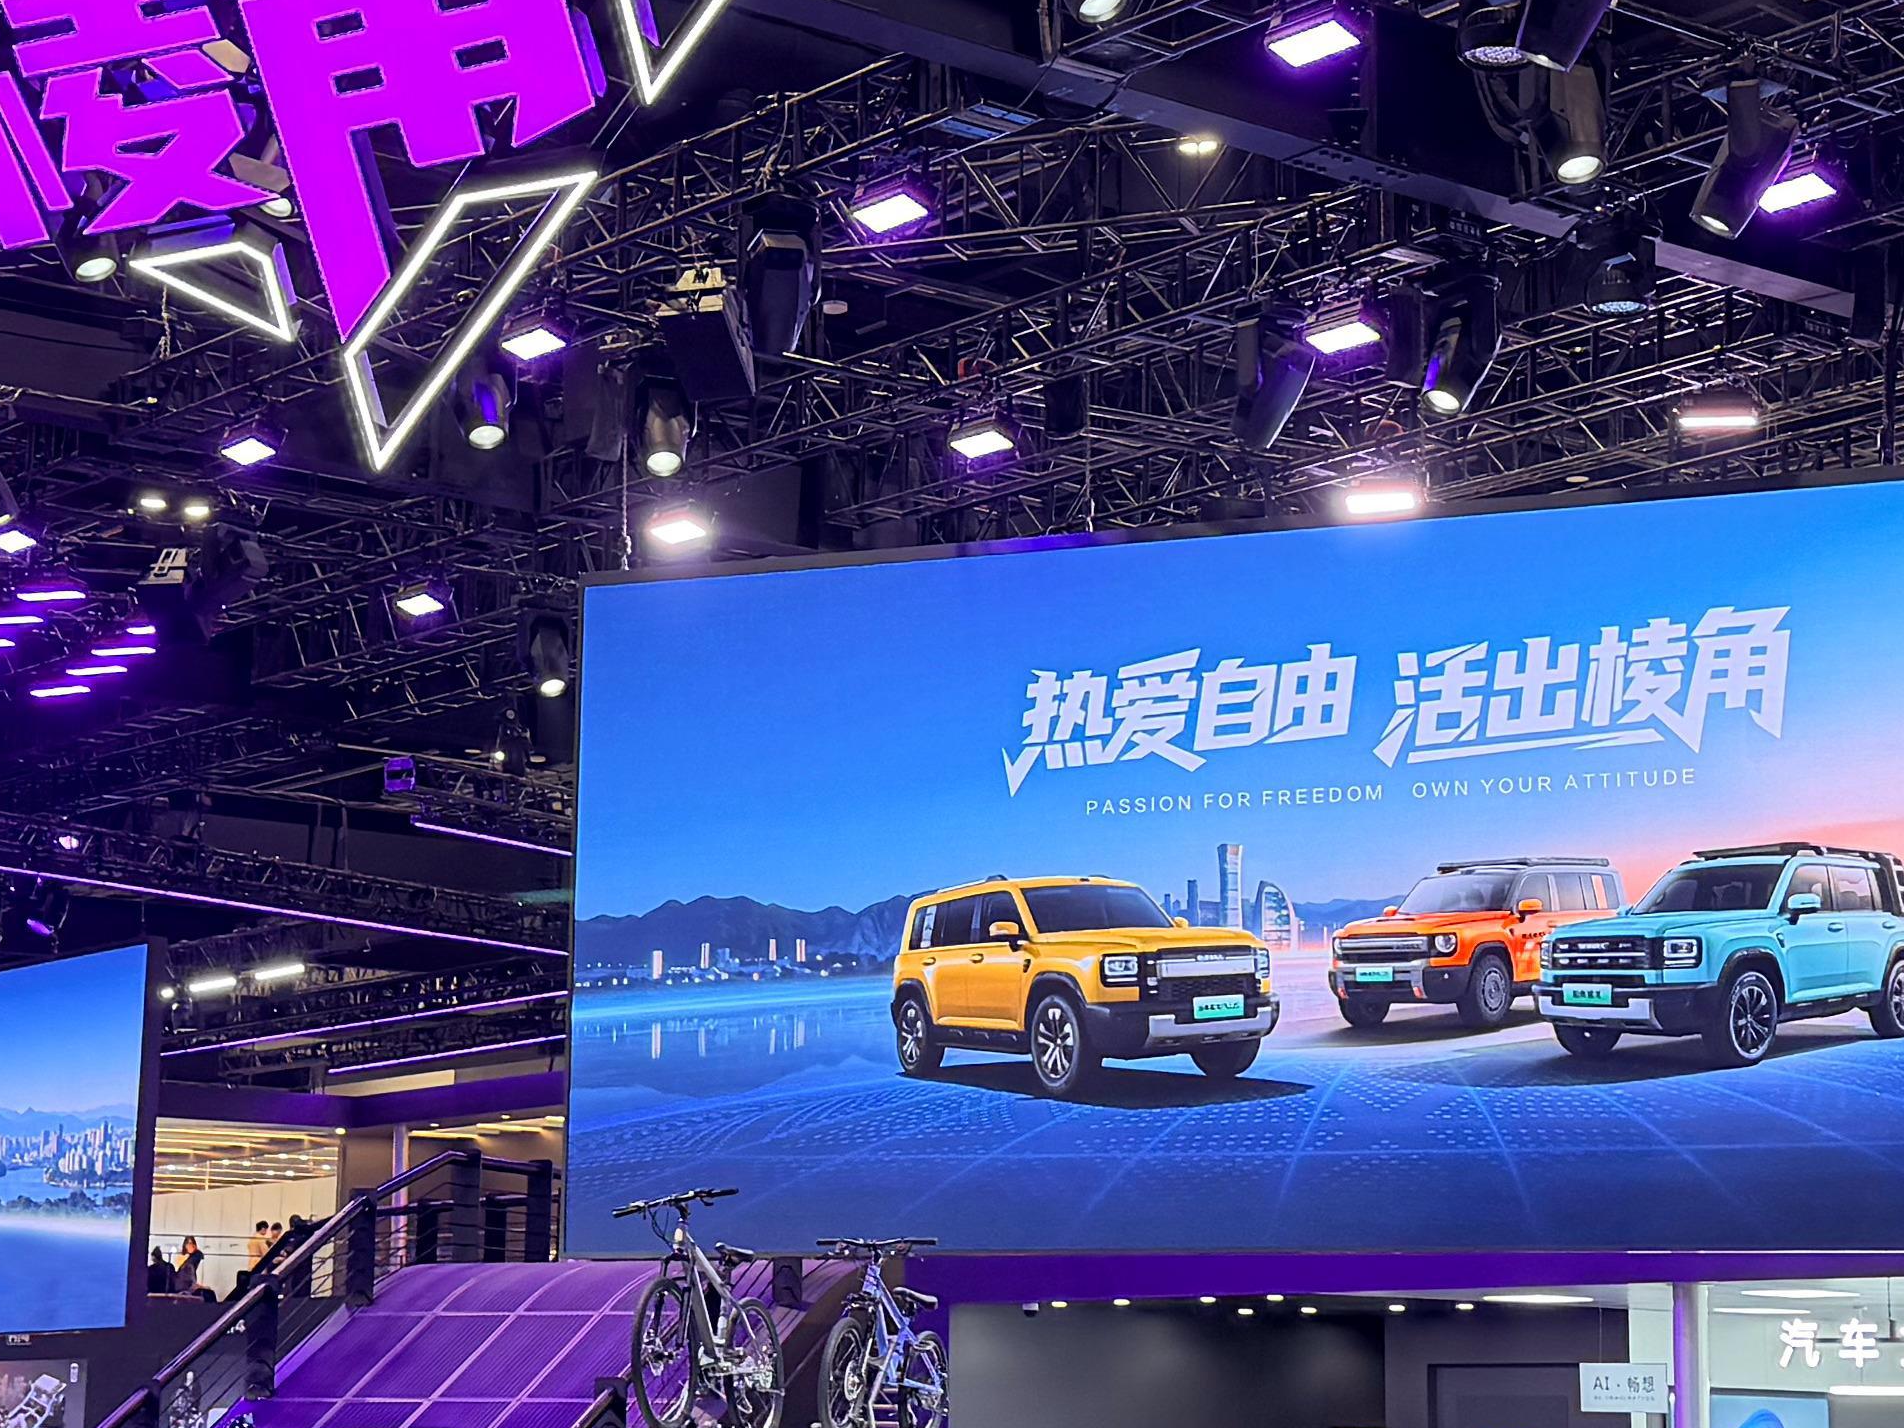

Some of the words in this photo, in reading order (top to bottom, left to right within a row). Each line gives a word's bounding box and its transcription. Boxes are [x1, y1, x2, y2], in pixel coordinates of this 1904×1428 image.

[1001, 642, 1358, 798] 热爱自由
[1373, 605, 1792, 768] 活出棱角
[1085, 794, 1193, 816] PASSION
[1203, 791, 1251, 810] FOR
[1262, 784, 1383, 806] FREEDOM
[1412, 779, 1469, 799] OWN
[1480, 774, 1552, 794] YOUR
[1564, 767, 1696, 790] ATTITUDE
